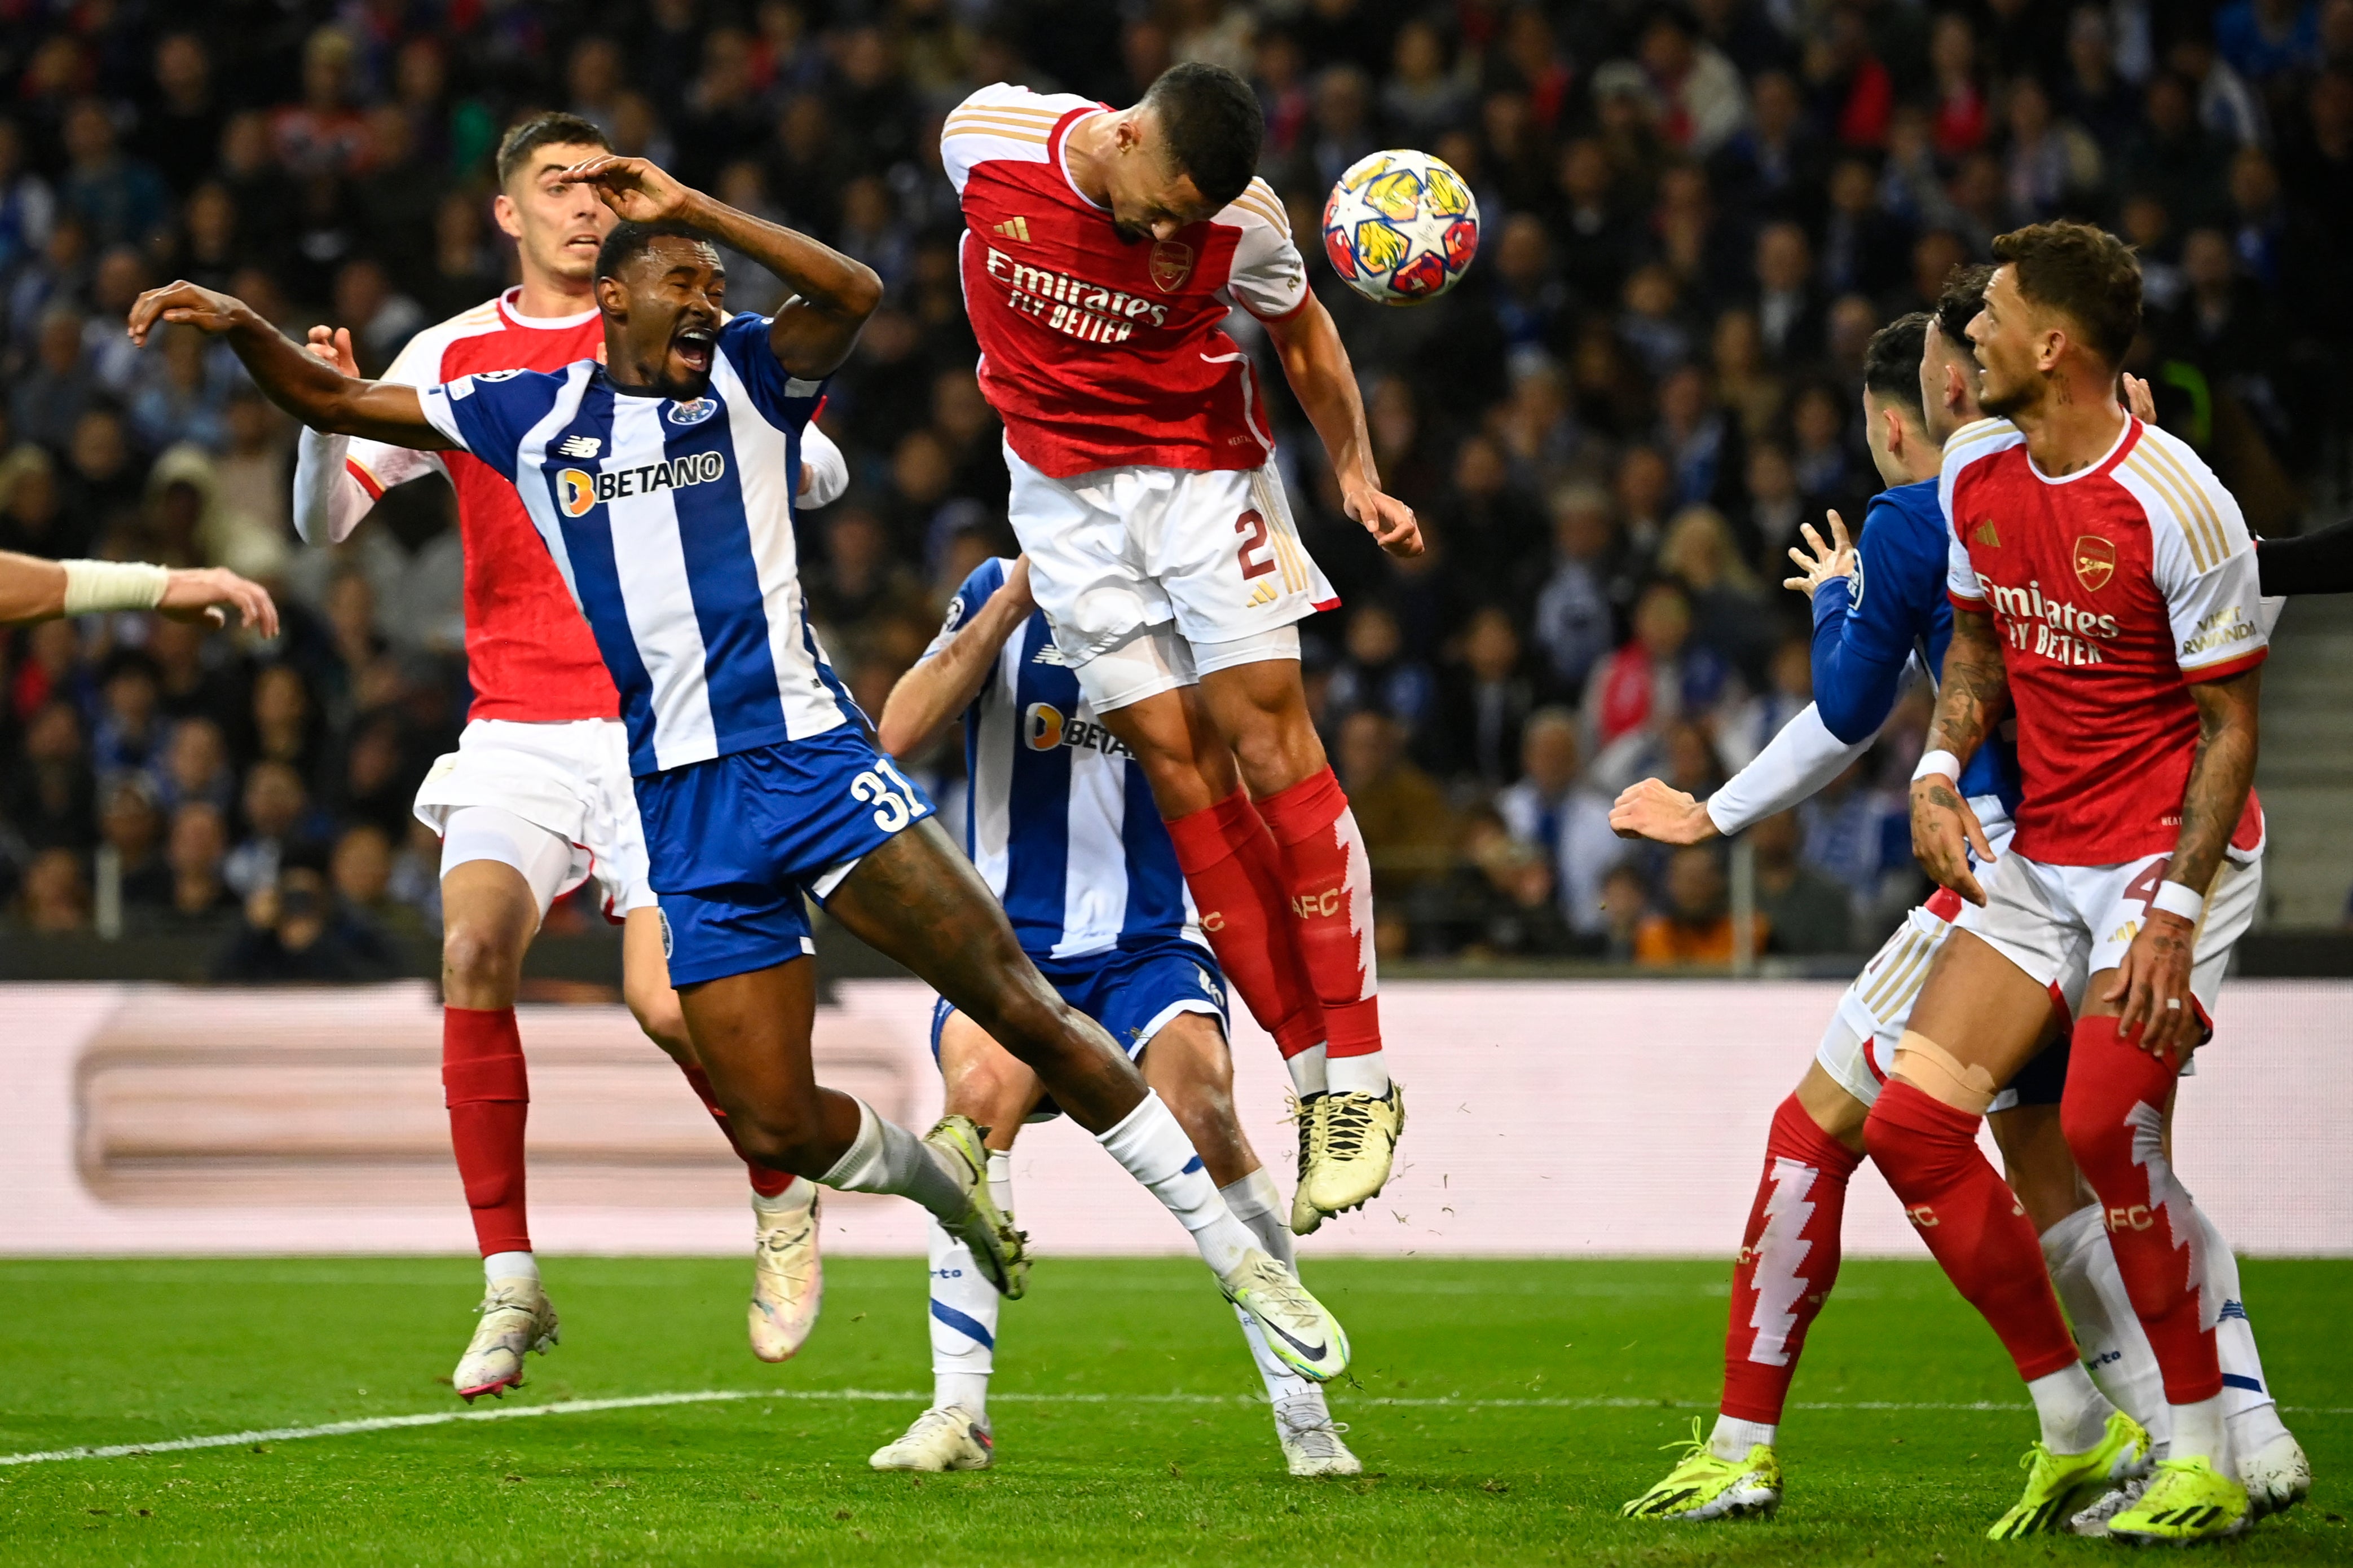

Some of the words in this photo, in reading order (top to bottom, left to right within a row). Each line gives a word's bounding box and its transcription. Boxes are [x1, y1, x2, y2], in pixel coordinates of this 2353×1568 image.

[986, 246, 1169, 327] Emirates
[1008, 289, 1046, 317] FLY
[1048, 304, 1135, 344] BETTER
[596, 450, 725, 502] BETANO
[1234, 508, 1277, 581] 2
[850, 758, 928, 833] 31
[2122, 857, 2171, 918] 4
